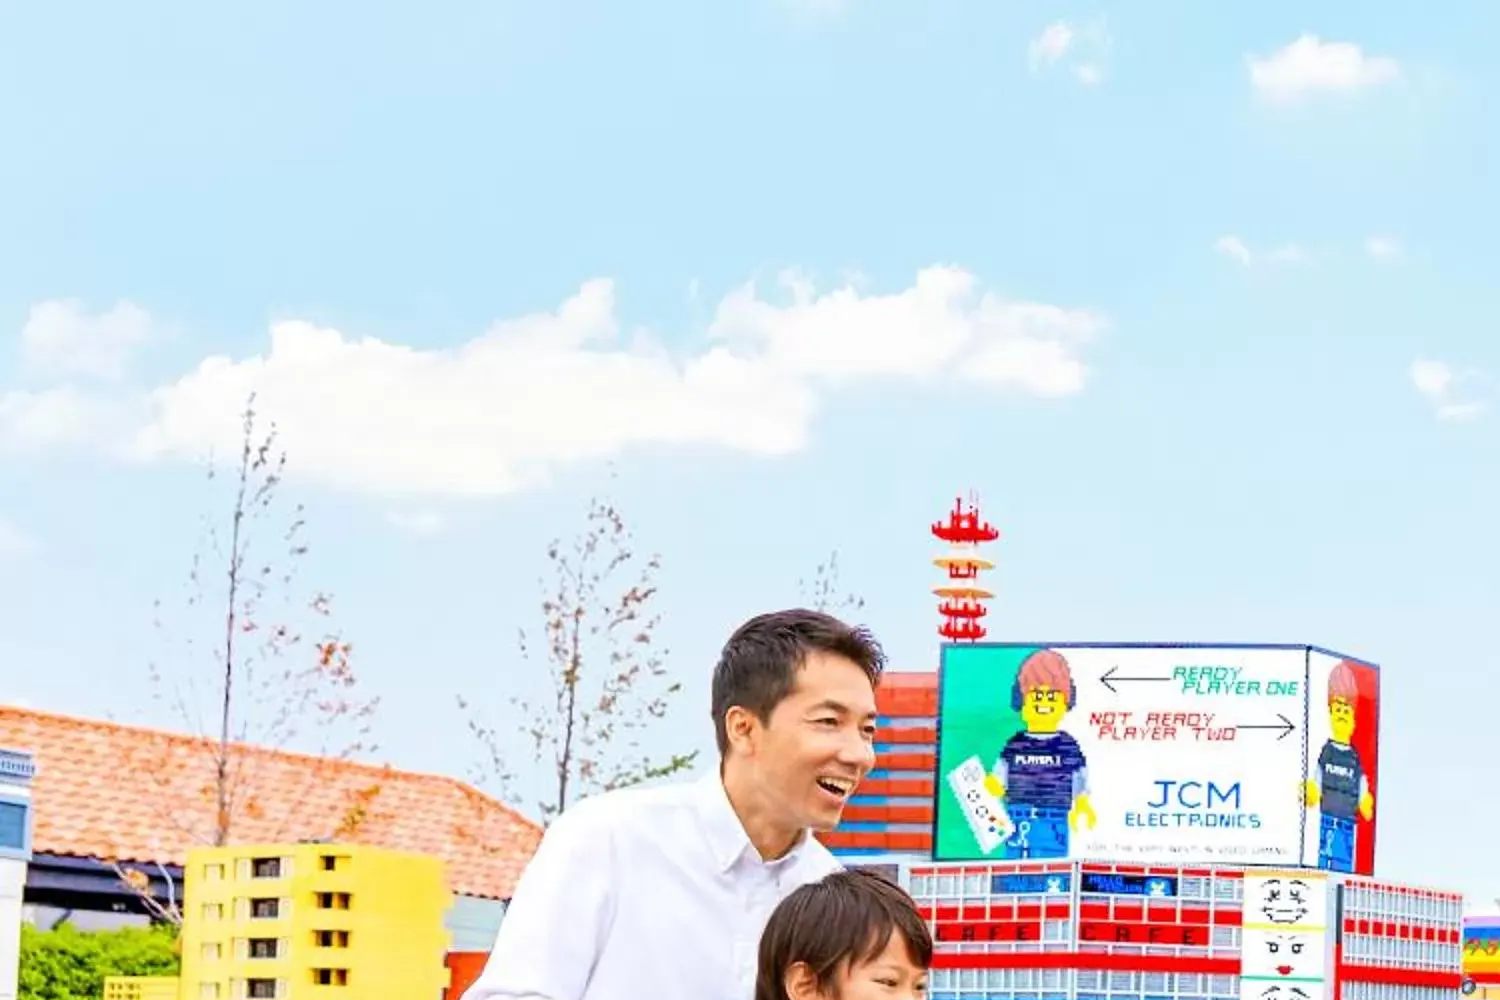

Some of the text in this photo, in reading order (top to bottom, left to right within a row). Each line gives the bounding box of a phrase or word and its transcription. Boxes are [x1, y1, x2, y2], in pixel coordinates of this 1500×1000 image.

[1172, 666, 1243, 681] READY
[1181, 681, 1299, 696] PLAYER ONE
[1089, 711, 1216, 727] NOT READY
[1097, 726, 1237, 742] PLAYER TWO
[1147, 780, 1242, 810] JCM
[1124, 812, 1262, 829] ELECTRONICS
[935, 922, 1028, 942] CAFE
[1081, 924, 1197, 947] CAFE
